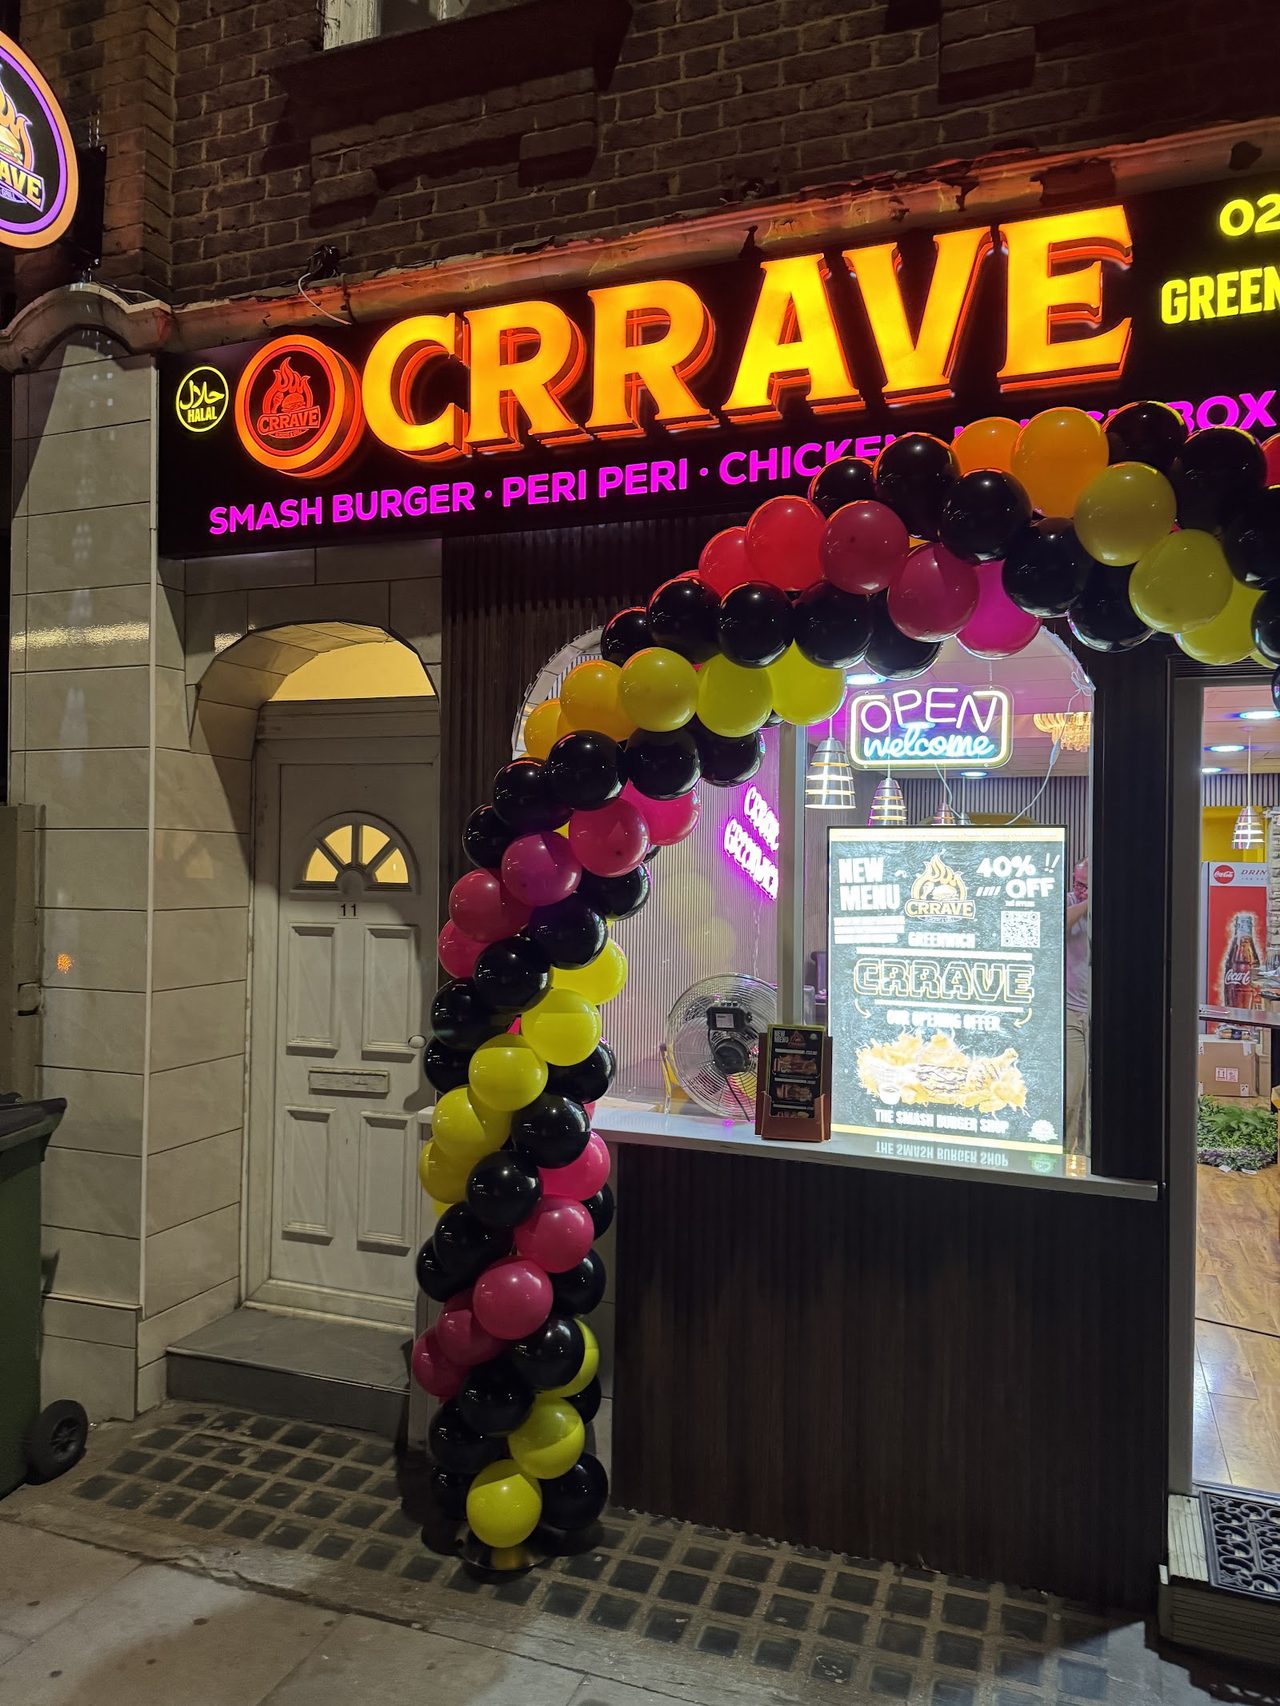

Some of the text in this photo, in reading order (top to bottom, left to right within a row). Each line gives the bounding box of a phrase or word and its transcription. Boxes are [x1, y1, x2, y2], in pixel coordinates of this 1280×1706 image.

[1219, 193, 1280, 237] 02
[361, 204, 1133, 457] CRRAVE
[179, 379, 226, 411] حلال
[186, 406, 218, 424] HALAL
[258, 408, 319, 433] CRRAVE
[209, 496, 323, 535] SMASH
[332, 481, 475, 523] BURGER
[502, 470, 587, 507] PERI
[598, 458, 688, 498] PERI
[860, 687, 998, 733] OPEN
[863, 726, 995, 758] welcome
[838, 857, 884, 884] NEW
[976, 855, 1036, 878] 40%
[840, 883, 900, 911] MENU
[1005, 877, 1055, 899] OFF
[340, 903, 356, 917] 11
[906, 900, 974, 918] CRRAVE
[854, 957, 1035, 1004] CRRAVE
[875, 1108, 894, 1123] THE
[896, 1110, 934, 1128] SMASH
